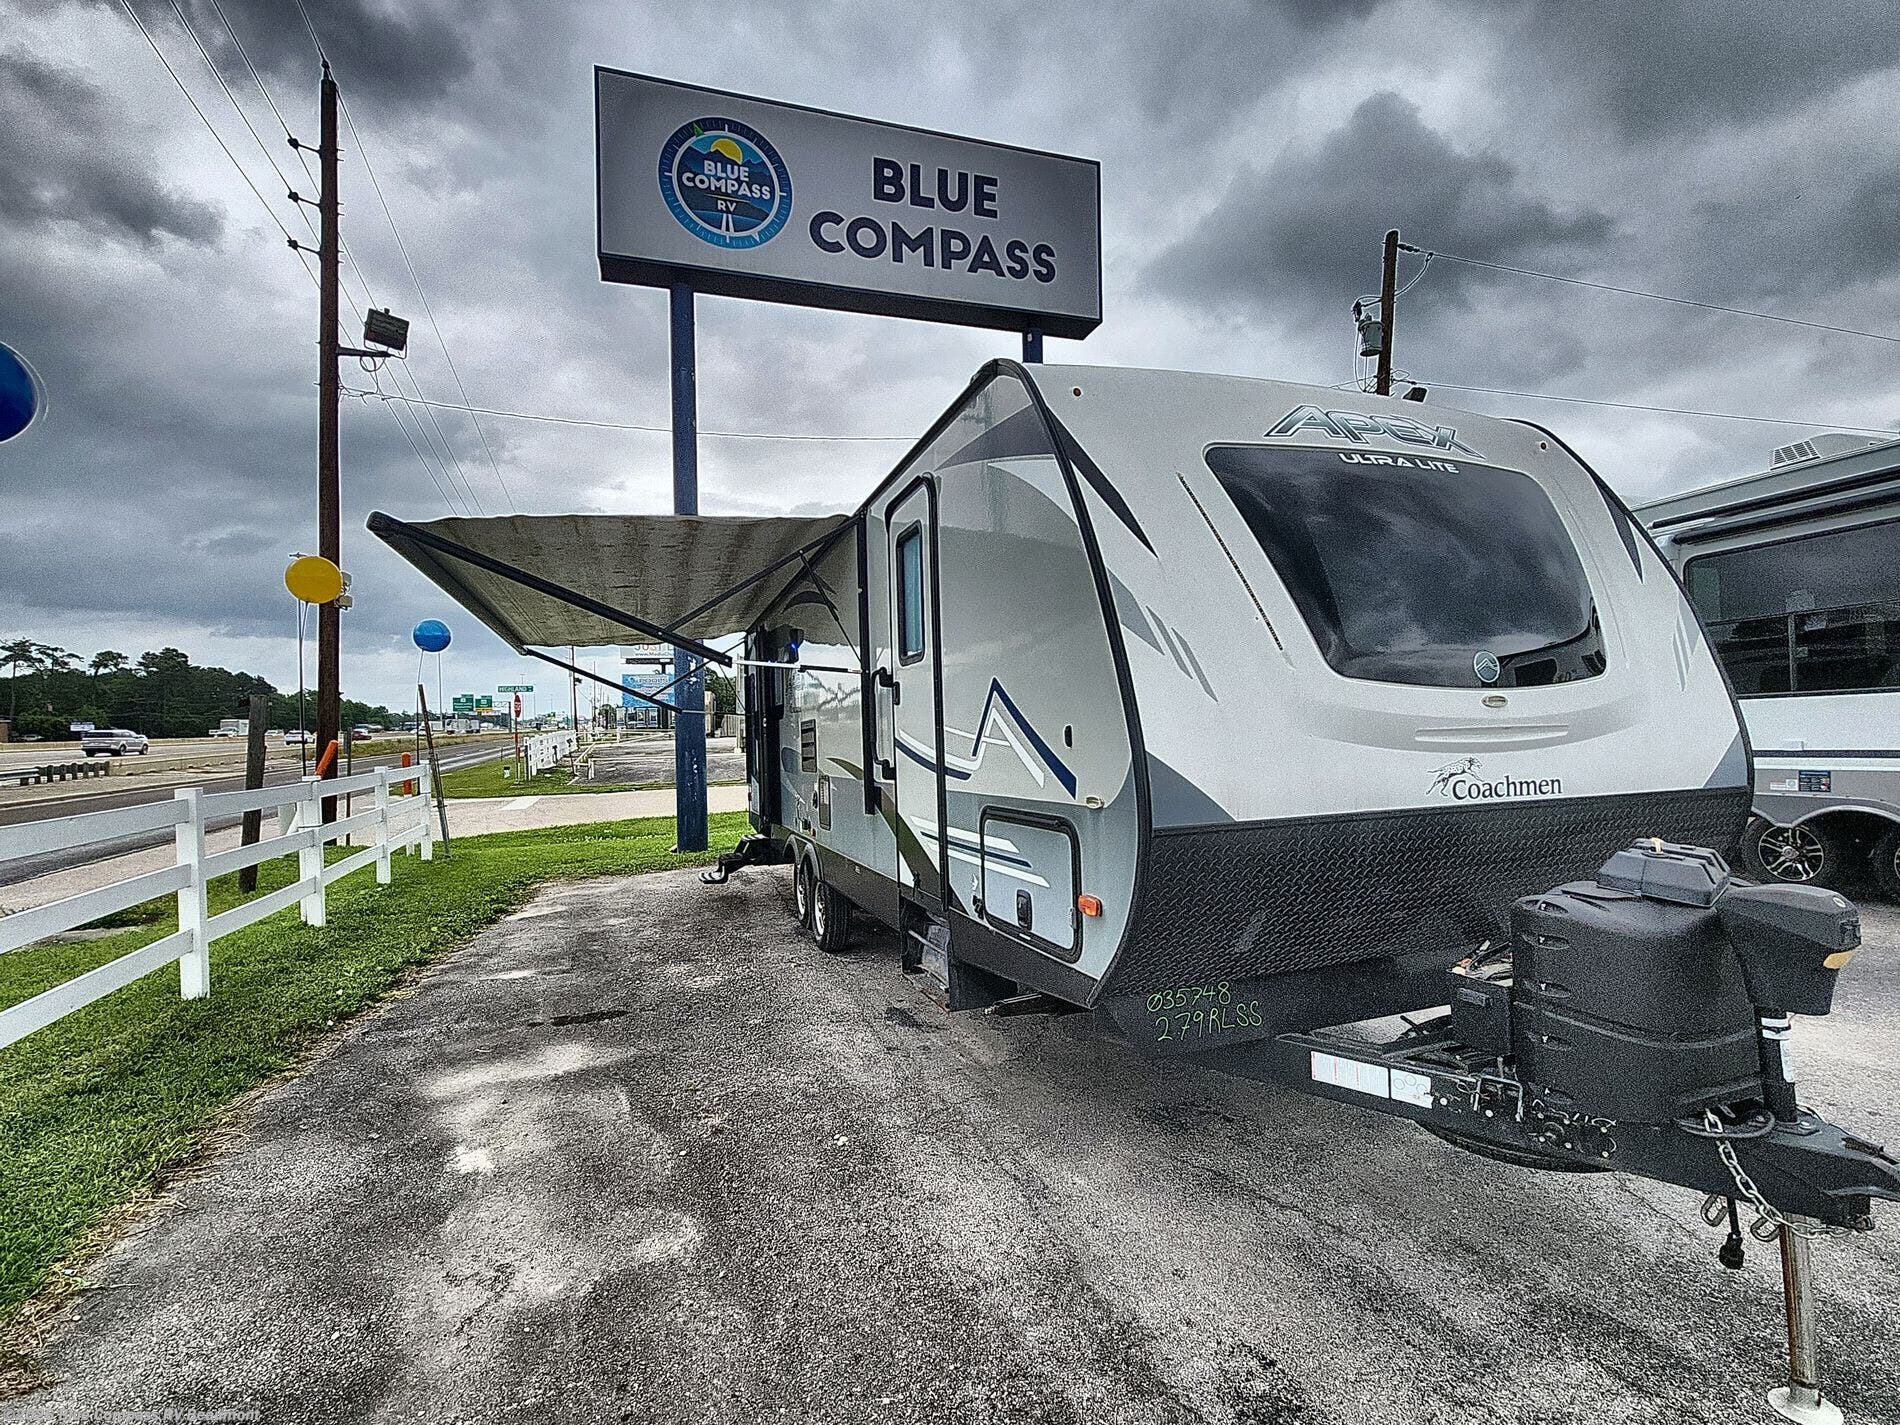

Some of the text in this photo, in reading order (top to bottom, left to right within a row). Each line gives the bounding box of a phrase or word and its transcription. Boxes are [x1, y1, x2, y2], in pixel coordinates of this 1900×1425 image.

[704, 160, 750, 182] BLUE
[681, 172, 771, 200] COMPASS
[872, 157, 999, 219] BLUE
[717, 200, 736, 212] RV
[808, 211, 1057, 283] COMPASS
[1263, 404, 1486, 459] APEX
[1338, 453, 1460, 474] ULTRA LITE
[1452, 775, 1563, 800] Coachmen
[1146, 981, 1231, 1012] 035748
